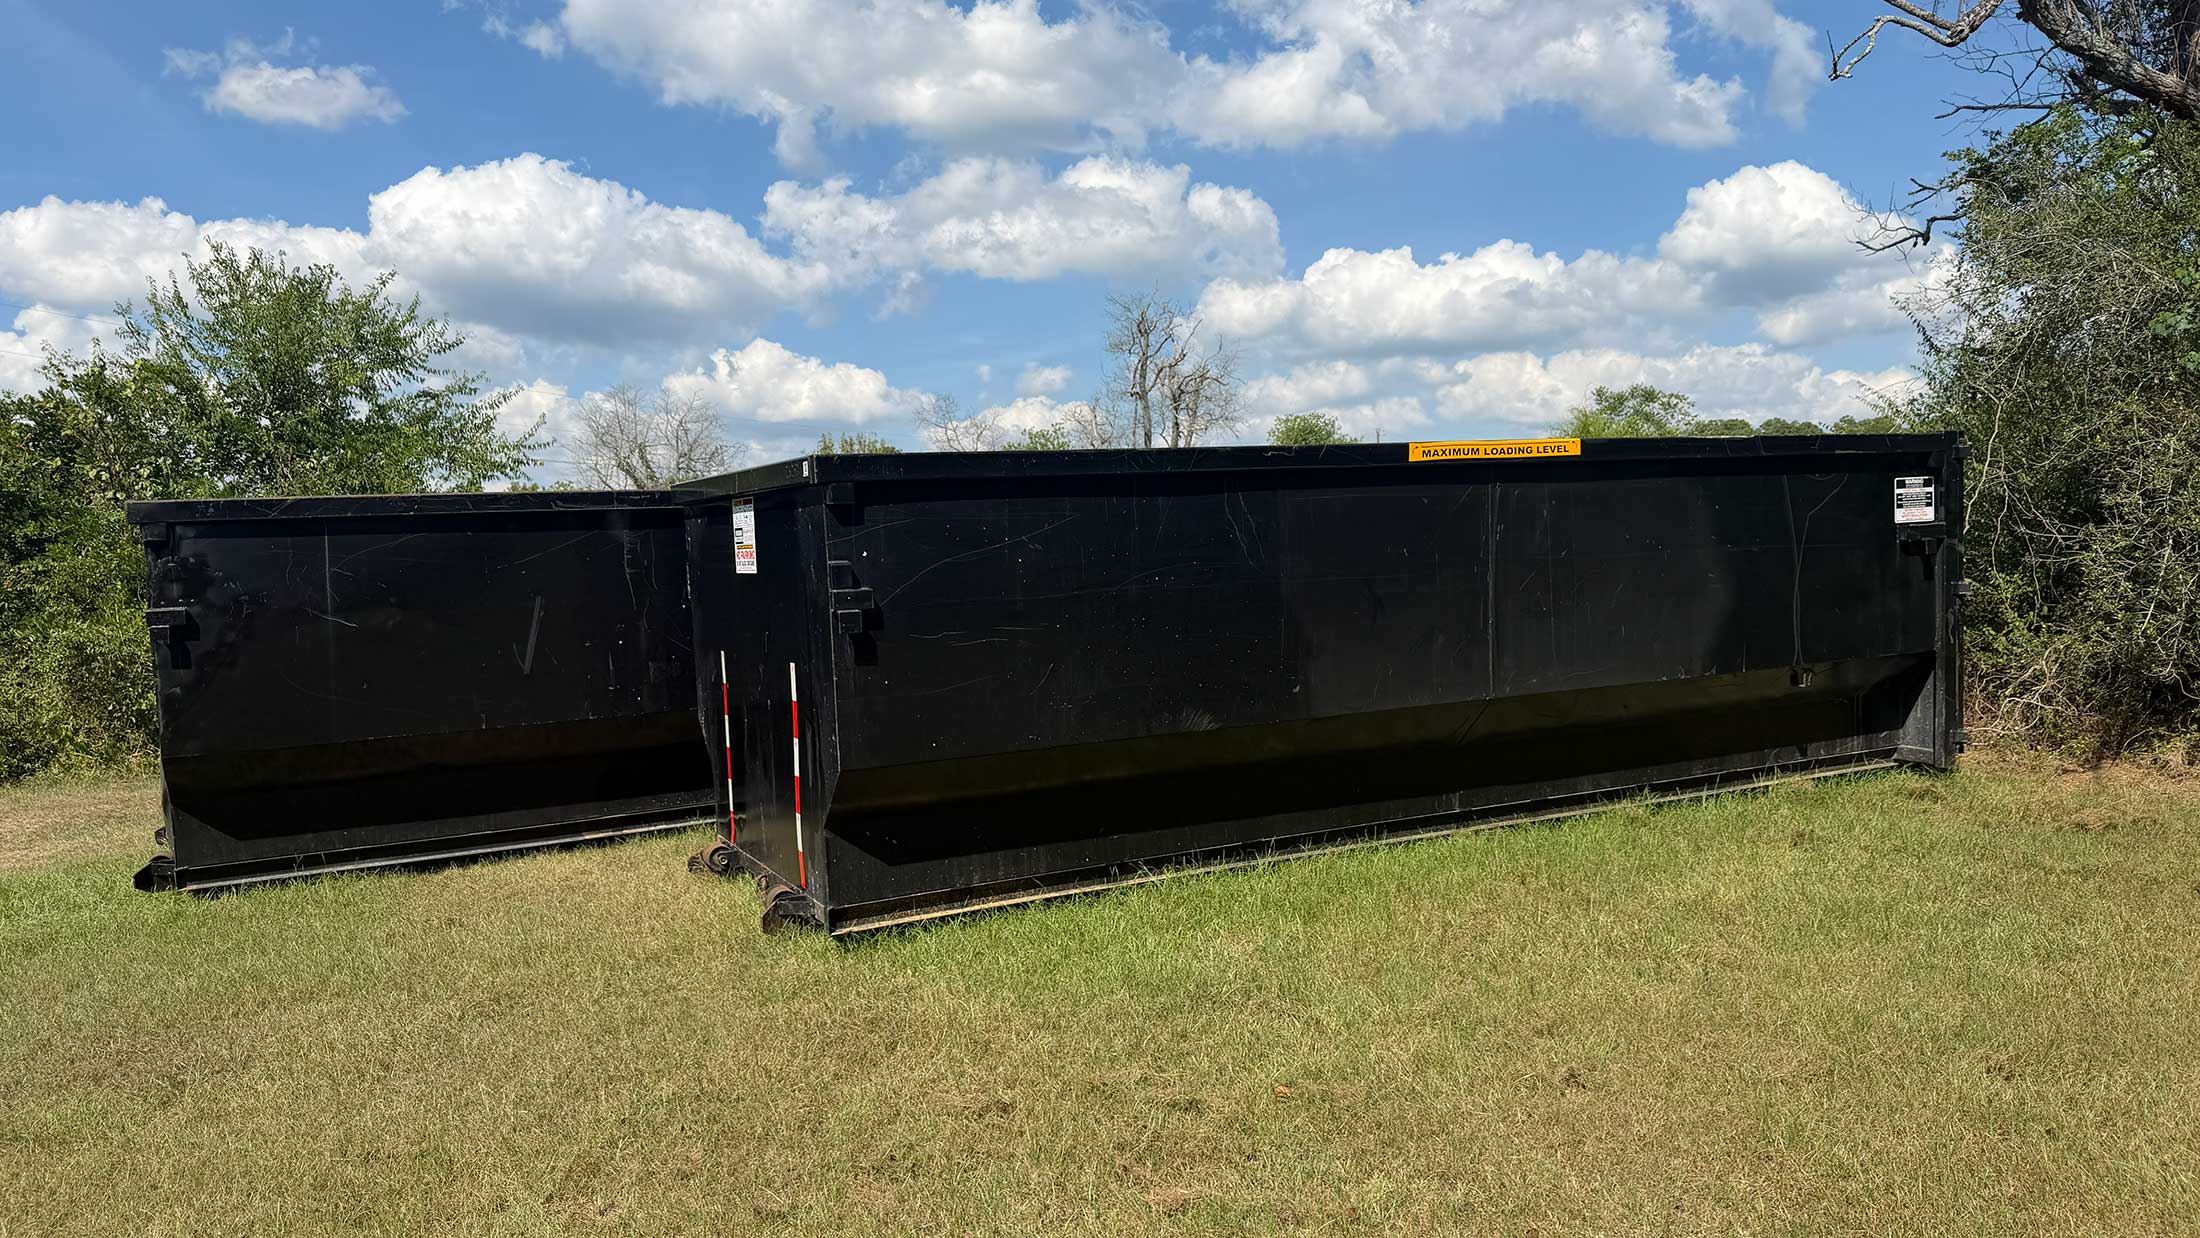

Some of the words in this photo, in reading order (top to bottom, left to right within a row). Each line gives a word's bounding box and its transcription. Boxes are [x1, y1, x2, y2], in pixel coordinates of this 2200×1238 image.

[1422, 447, 1480, 458] MAXIMUM
[1484, 446, 1533, 456] LOADING
[1536, 445, 1569, 454] LEVEL
